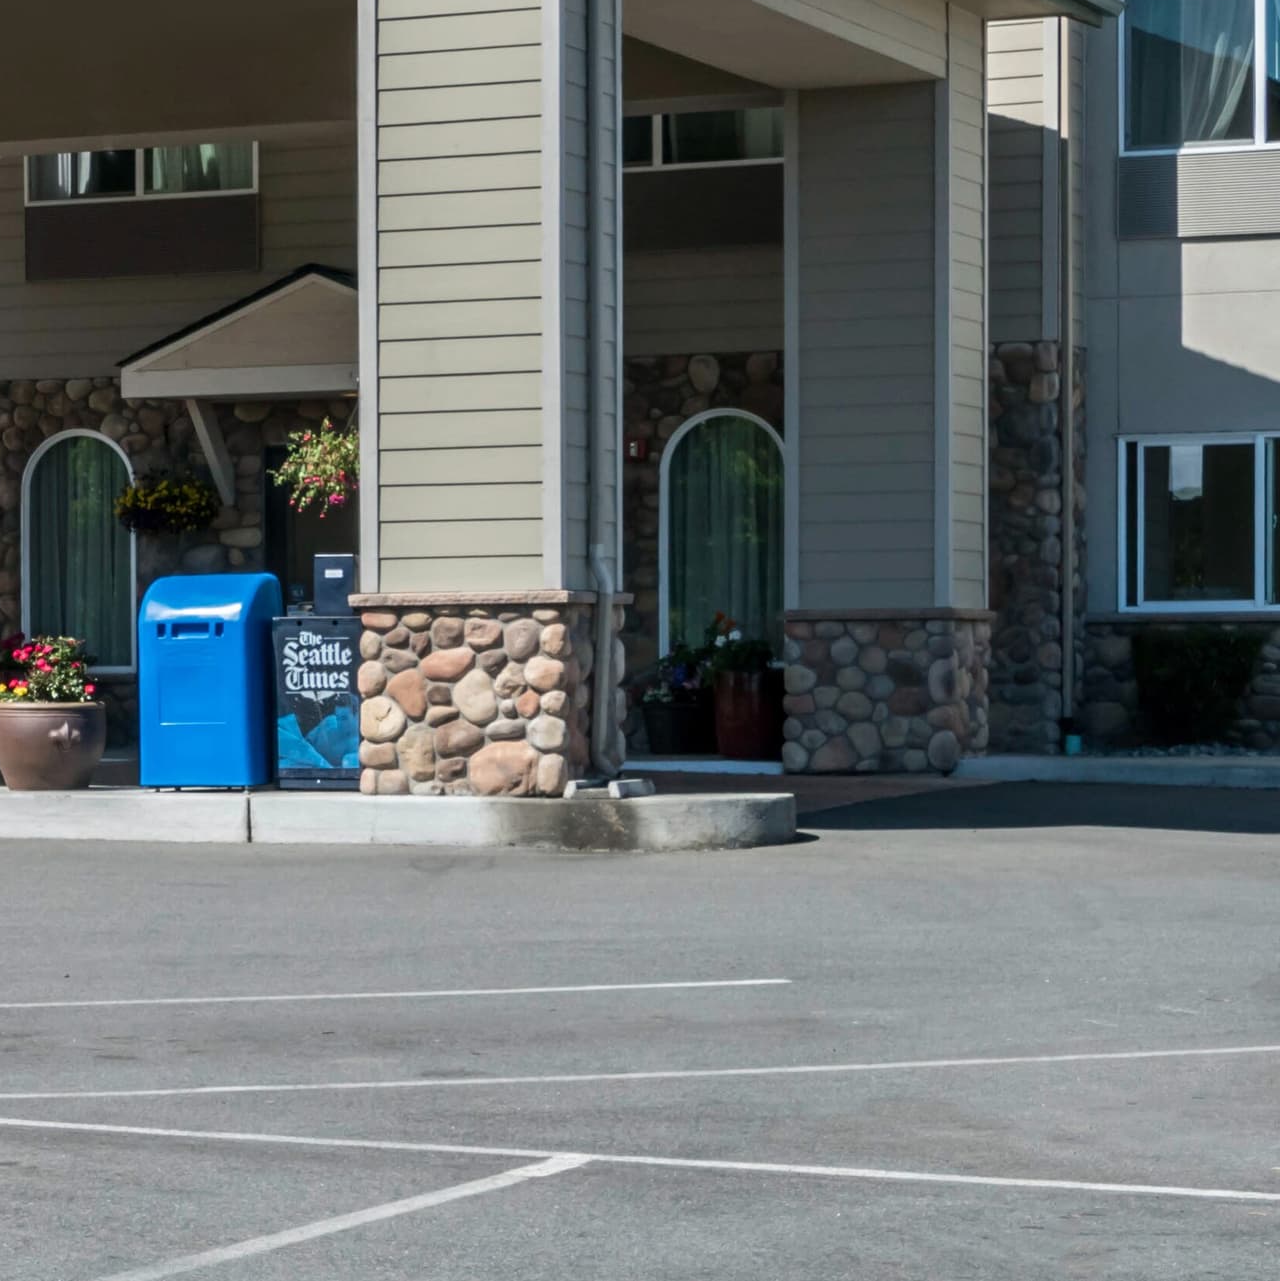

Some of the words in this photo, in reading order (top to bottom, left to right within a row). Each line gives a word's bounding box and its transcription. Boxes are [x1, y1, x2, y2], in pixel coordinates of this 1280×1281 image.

[299, 631, 322, 646] The
[282, 641, 353, 666] Seattle
[284, 666, 350, 690] Times
